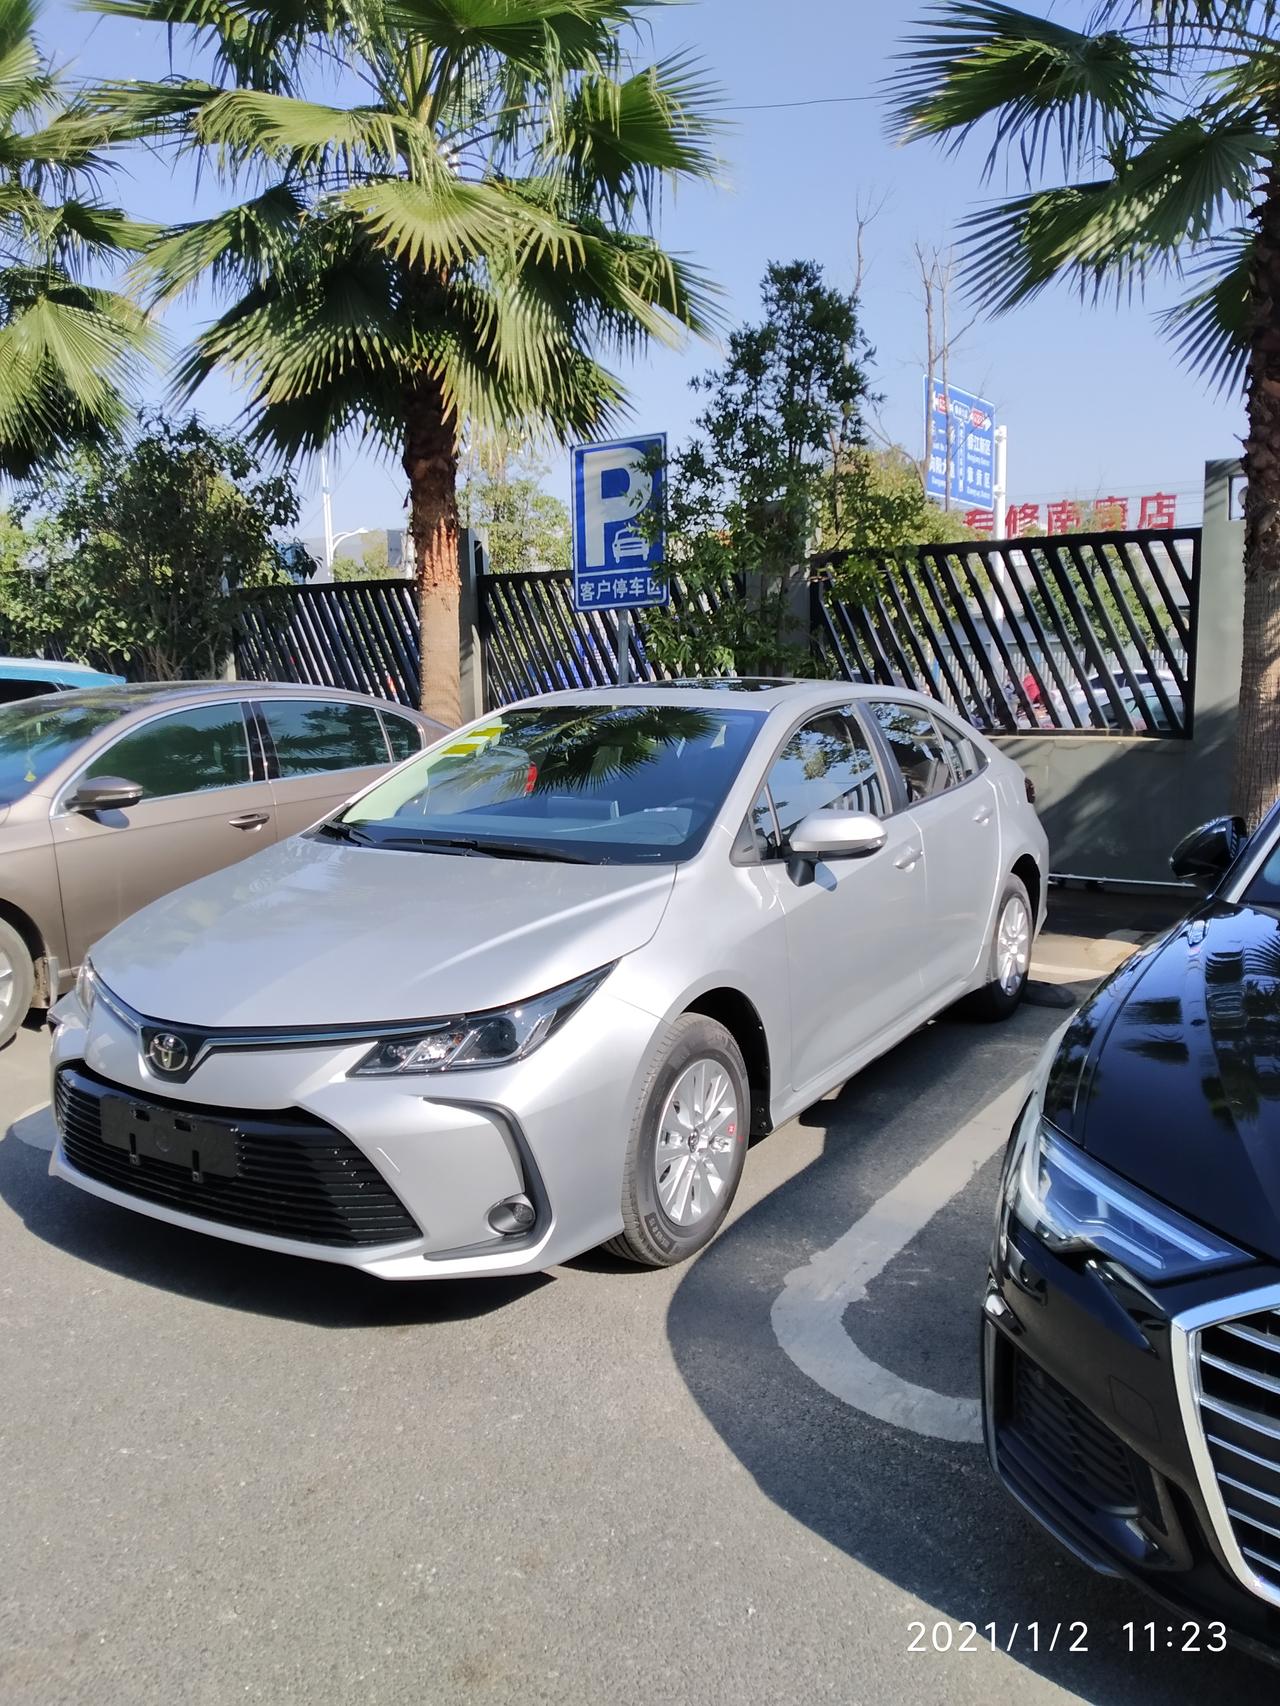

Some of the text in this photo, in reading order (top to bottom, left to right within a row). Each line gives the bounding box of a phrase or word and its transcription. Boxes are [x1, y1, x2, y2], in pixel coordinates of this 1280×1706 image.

[583, 446, 653, 568] P
[580, 576, 662, 602] 客户停车区
